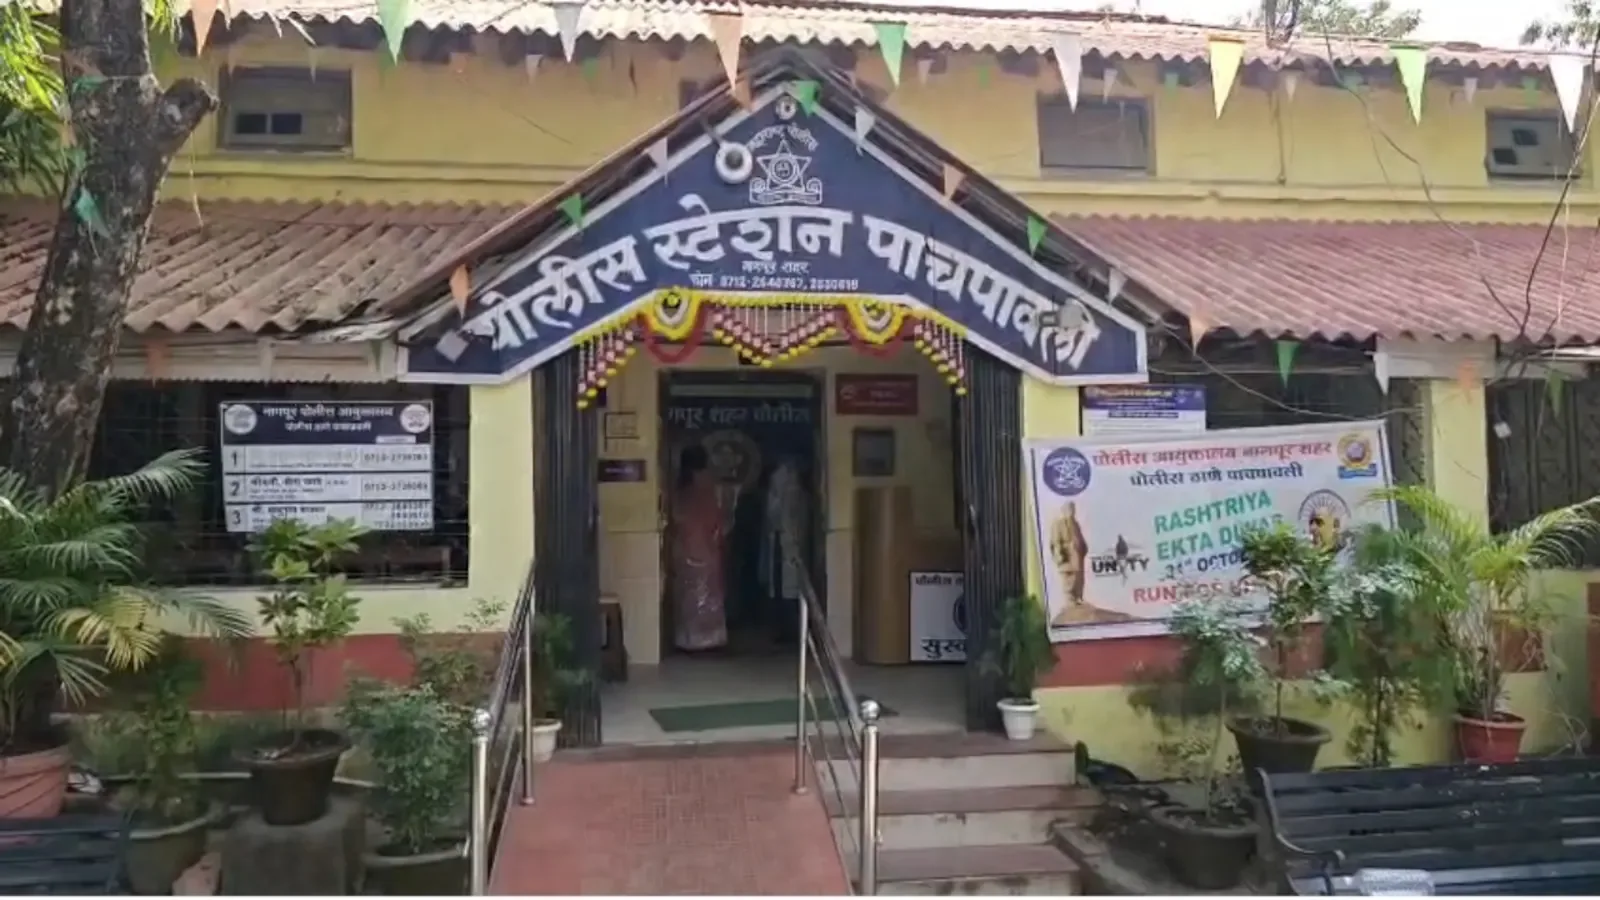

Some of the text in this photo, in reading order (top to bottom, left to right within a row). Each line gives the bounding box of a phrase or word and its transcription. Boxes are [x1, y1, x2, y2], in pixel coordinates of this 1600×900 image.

[460, 194, 1101, 370] पोलीस स्टेशन पाचपावली
[300, 403, 335, 417] पोलीस
[1092, 448, 1147, 466] पोलीस
[1152, 446, 1237, 466] आयुक्तालय
[1243, 444, 1296, 461] नागपूर
[1298, 442, 1332, 456] शहर
[1130, 469, 1184, 486] पोलीस
[1189, 466, 1222, 484] ठाणे
[230, 481, 240, 497] 2
[232, 510, 241, 525] 3
[1154, 489, 1272, 535] RASHTRIYA
[1156, 531, 1213, 560] EKTA
[1133, 584, 1176, 603] RUN
